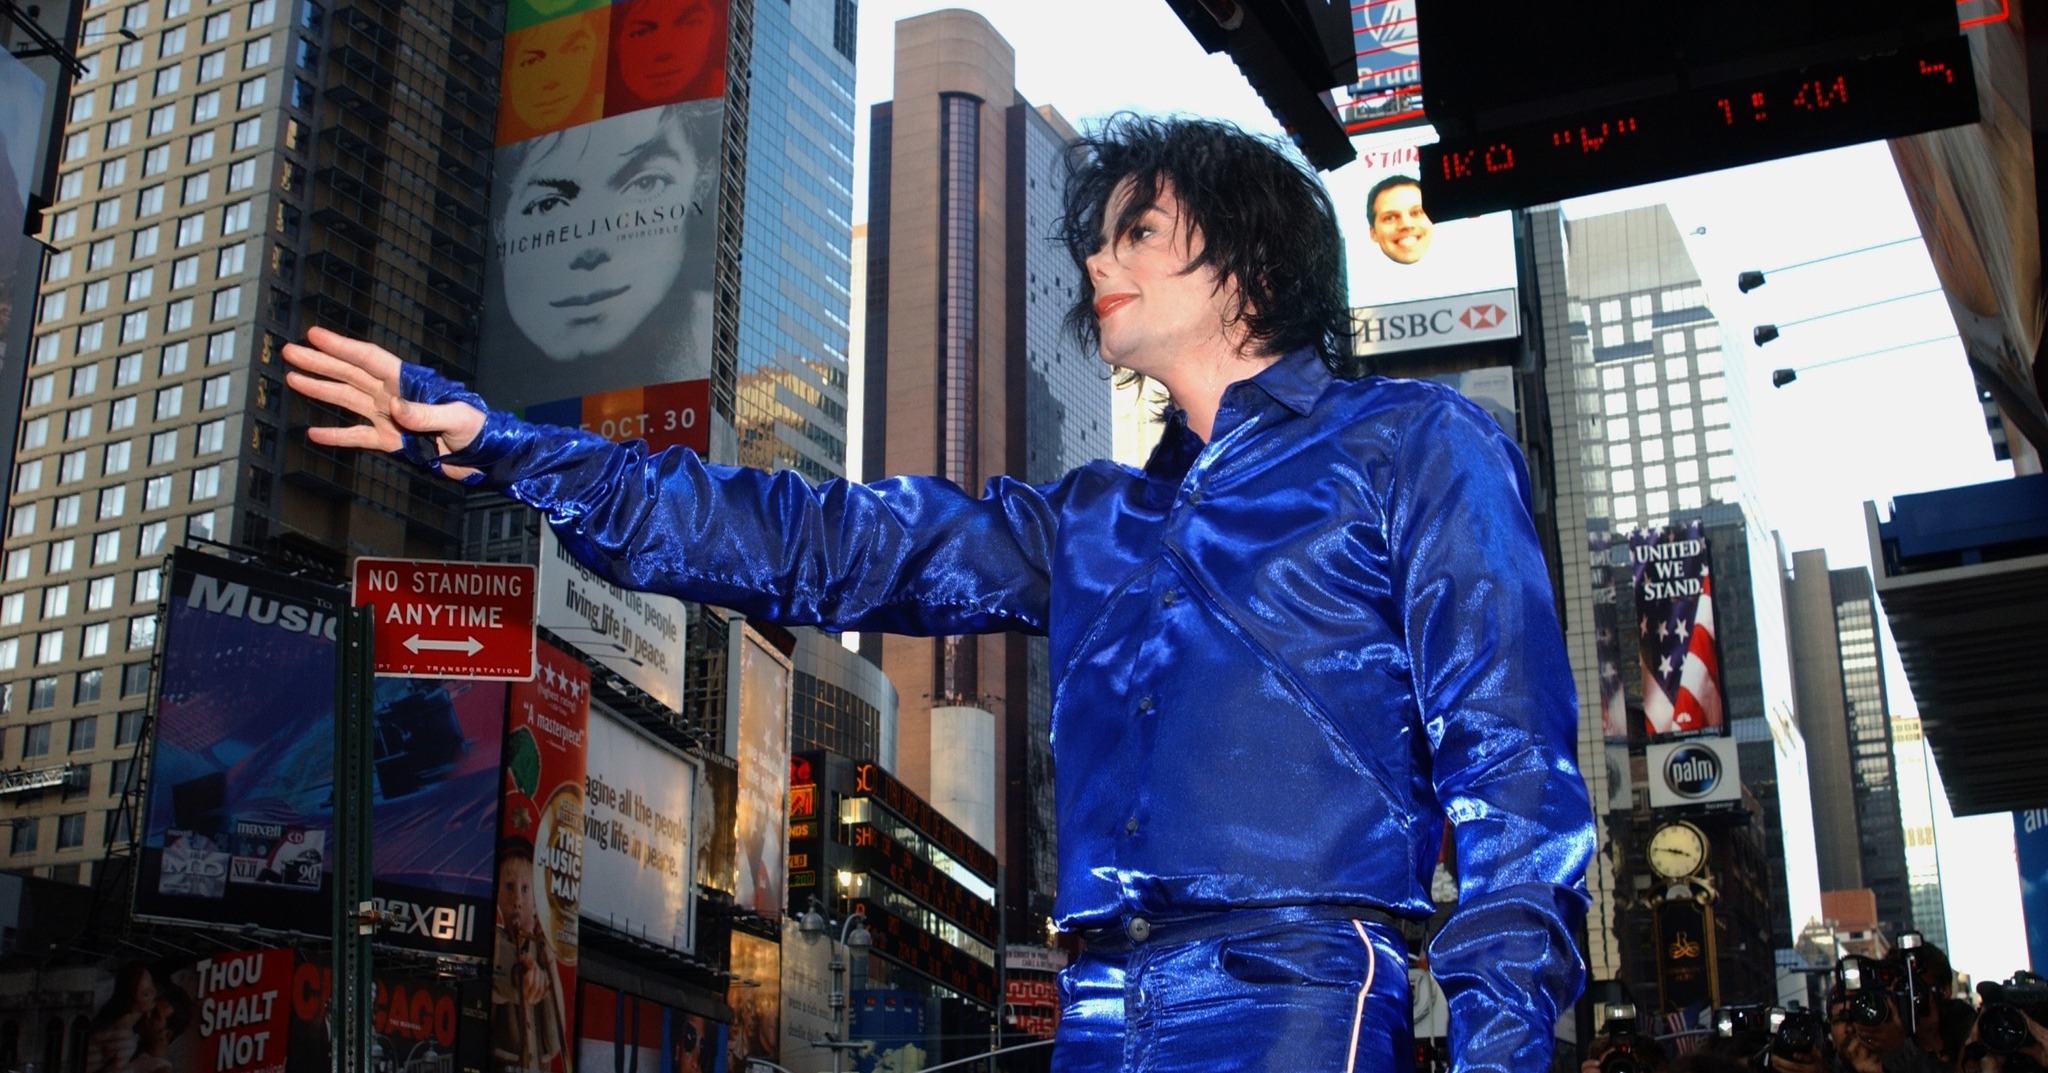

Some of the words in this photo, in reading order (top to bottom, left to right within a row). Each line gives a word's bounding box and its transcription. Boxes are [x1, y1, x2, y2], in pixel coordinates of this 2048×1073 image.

[1363, 309, 1455, 345] HSBC
[601, 415, 655, 440] OCT.
[664, 407, 696, 431] 30
[1635, 539, 1700, 563] UNITED
[368, 569, 399, 592] NO
[412, 571, 522, 597] STANDING
[1654, 560, 1685, 579] WE
[385, 602, 504, 629] ANYTIME
[566, 578, 600, 634] living
[601, 601, 621, 642] life
[622, 617, 633, 649] in
[634, 633, 669, 676] peace.
[644, 602, 677, 643] people
[402, 664, 416, 672] OF
[427, 665, 521, 675] TRANSPORTATION
[1672, 757, 1714, 785] palm
[237, 822, 282, 839] maxell
[287, 831, 304, 843] CD
[618, 788, 632, 818] all
[634, 794, 652, 829] the
[655, 811, 687, 847] people
[557, 827, 582, 857] THE
[611, 820, 629, 855] life
[631, 831, 642, 862] in
[643, 845, 678, 878] peace.
[298, 864, 319, 882] 90
[538, 846, 581, 879] MUSIC
[551, 873, 579, 902] MAN
[197, 953, 265, 1000] THOU
[200, 990, 278, 1038] SHALT
[217, 1031, 270, 1073] NOT
